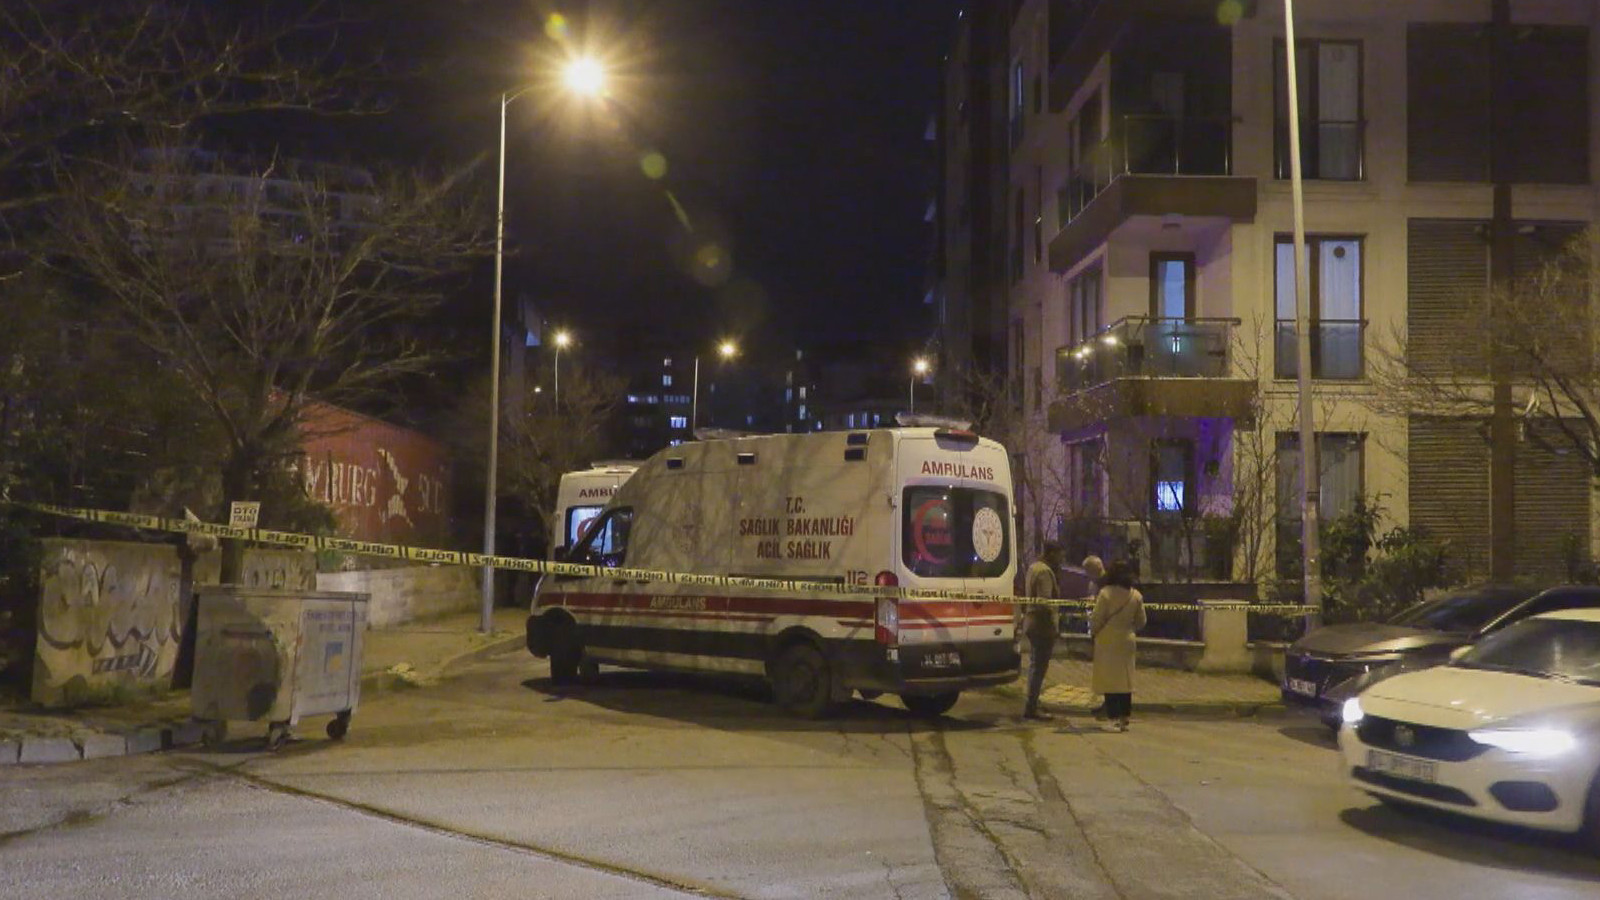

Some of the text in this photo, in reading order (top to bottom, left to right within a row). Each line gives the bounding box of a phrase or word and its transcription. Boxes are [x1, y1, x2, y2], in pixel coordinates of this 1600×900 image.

[921, 461, 994, 480] AMBULANS
[579, 488, 619, 498] AMBU
[785, 496, 806, 514] T.C.
[739, 515, 854, 536] SAĞLIK BAKANLIĞI
[757, 538, 831, 560] ACİL SAĞLIK
[847, 570, 869, 585] 112
